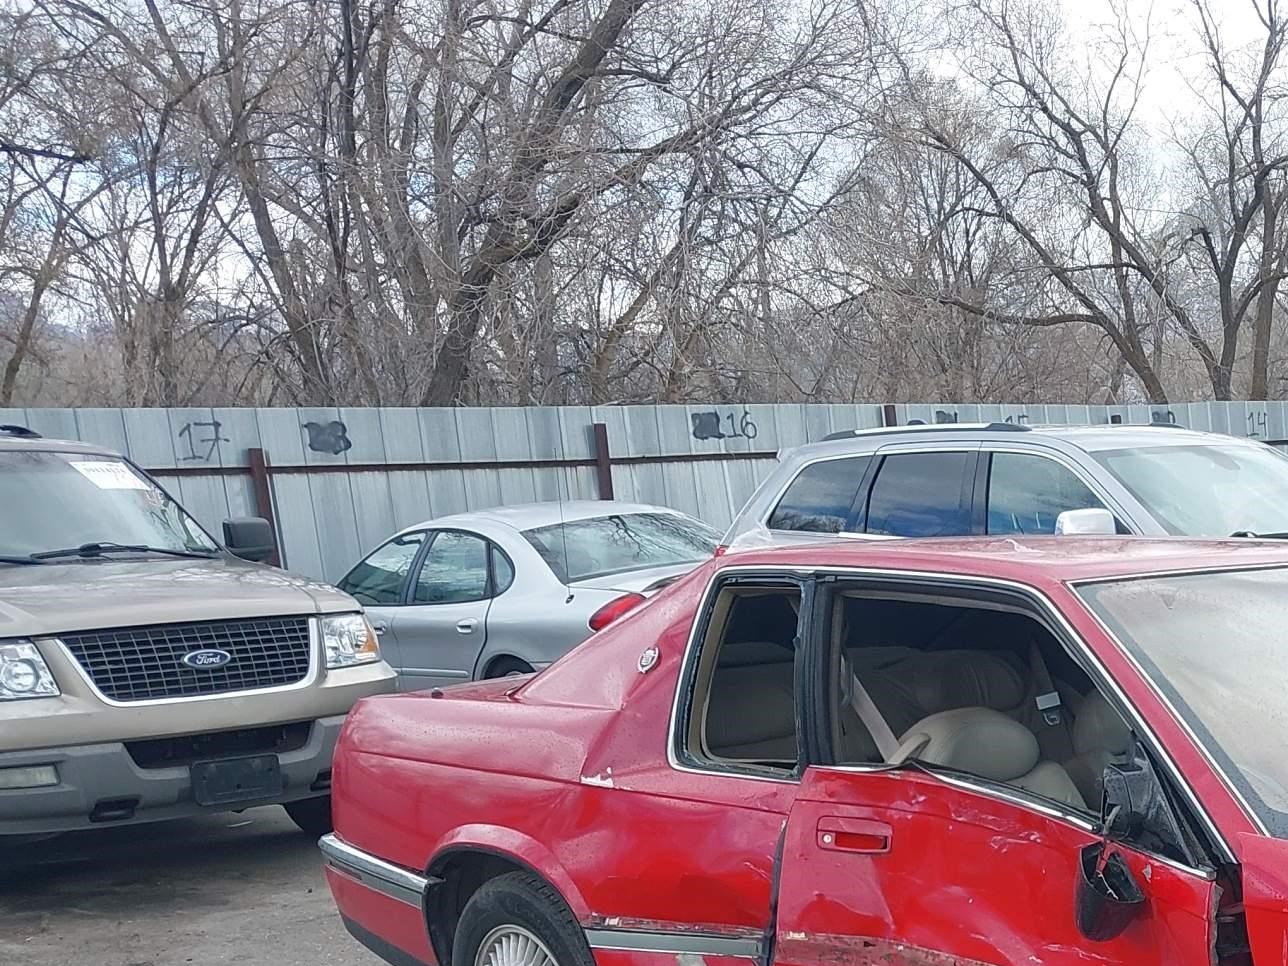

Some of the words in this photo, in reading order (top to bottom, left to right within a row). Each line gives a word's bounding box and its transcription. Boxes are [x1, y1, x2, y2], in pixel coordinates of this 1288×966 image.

[726, 411, 757, 439] 16
[1246, 411, 1267, 438] 14
[177, 421, 230, 461] 17
[196, 653, 220, 665] Ford
